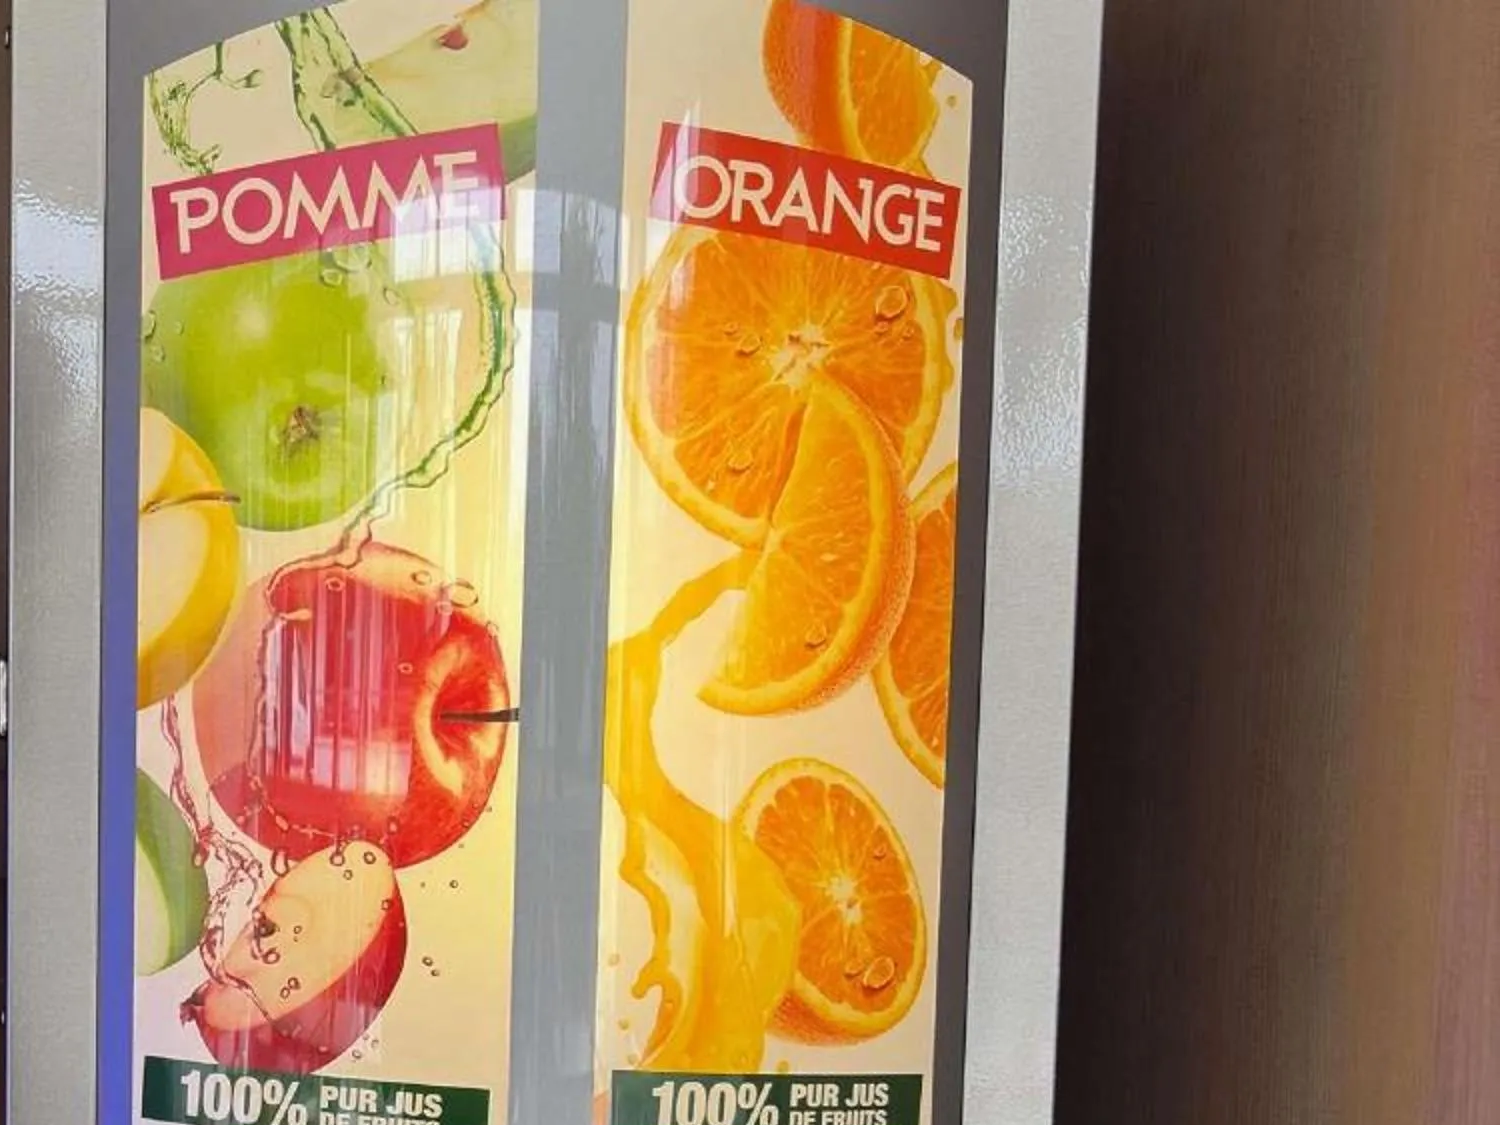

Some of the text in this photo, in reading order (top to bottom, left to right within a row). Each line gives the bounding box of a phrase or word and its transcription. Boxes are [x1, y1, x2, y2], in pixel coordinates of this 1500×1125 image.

[170, 150, 479, 253] POMME
[673, 155, 945, 252] ORANGE
[319, 1084, 377, 1113] PUR
[386, 1091, 443, 1119] JUS
[790, 1083, 841, 1107] PUR
[845, 1083, 889, 1107] JUS
